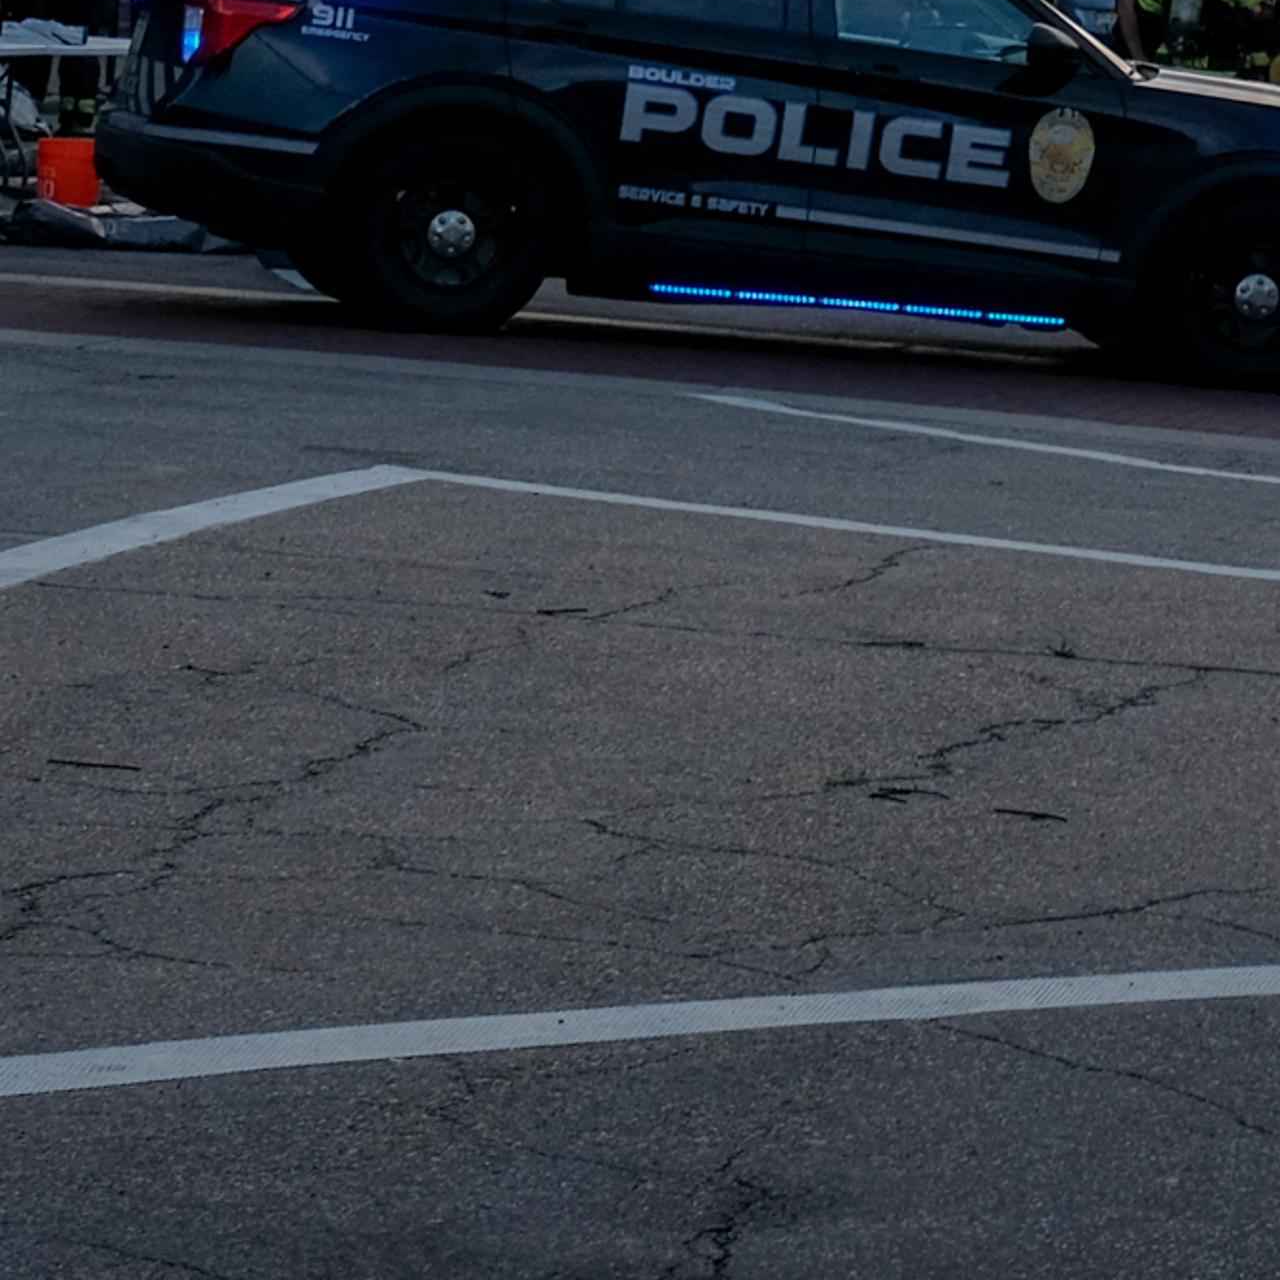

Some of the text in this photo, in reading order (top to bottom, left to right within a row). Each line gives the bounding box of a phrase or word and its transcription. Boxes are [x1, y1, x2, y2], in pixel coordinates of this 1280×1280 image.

[312, 4, 355, 29] 911
[628, 64, 737, 90] BOULDER
[619, 82, 1013, 188] POLICE
[617, 184, 687, 207] SERVICE
[707, 196, 770, 217] SAFETY
